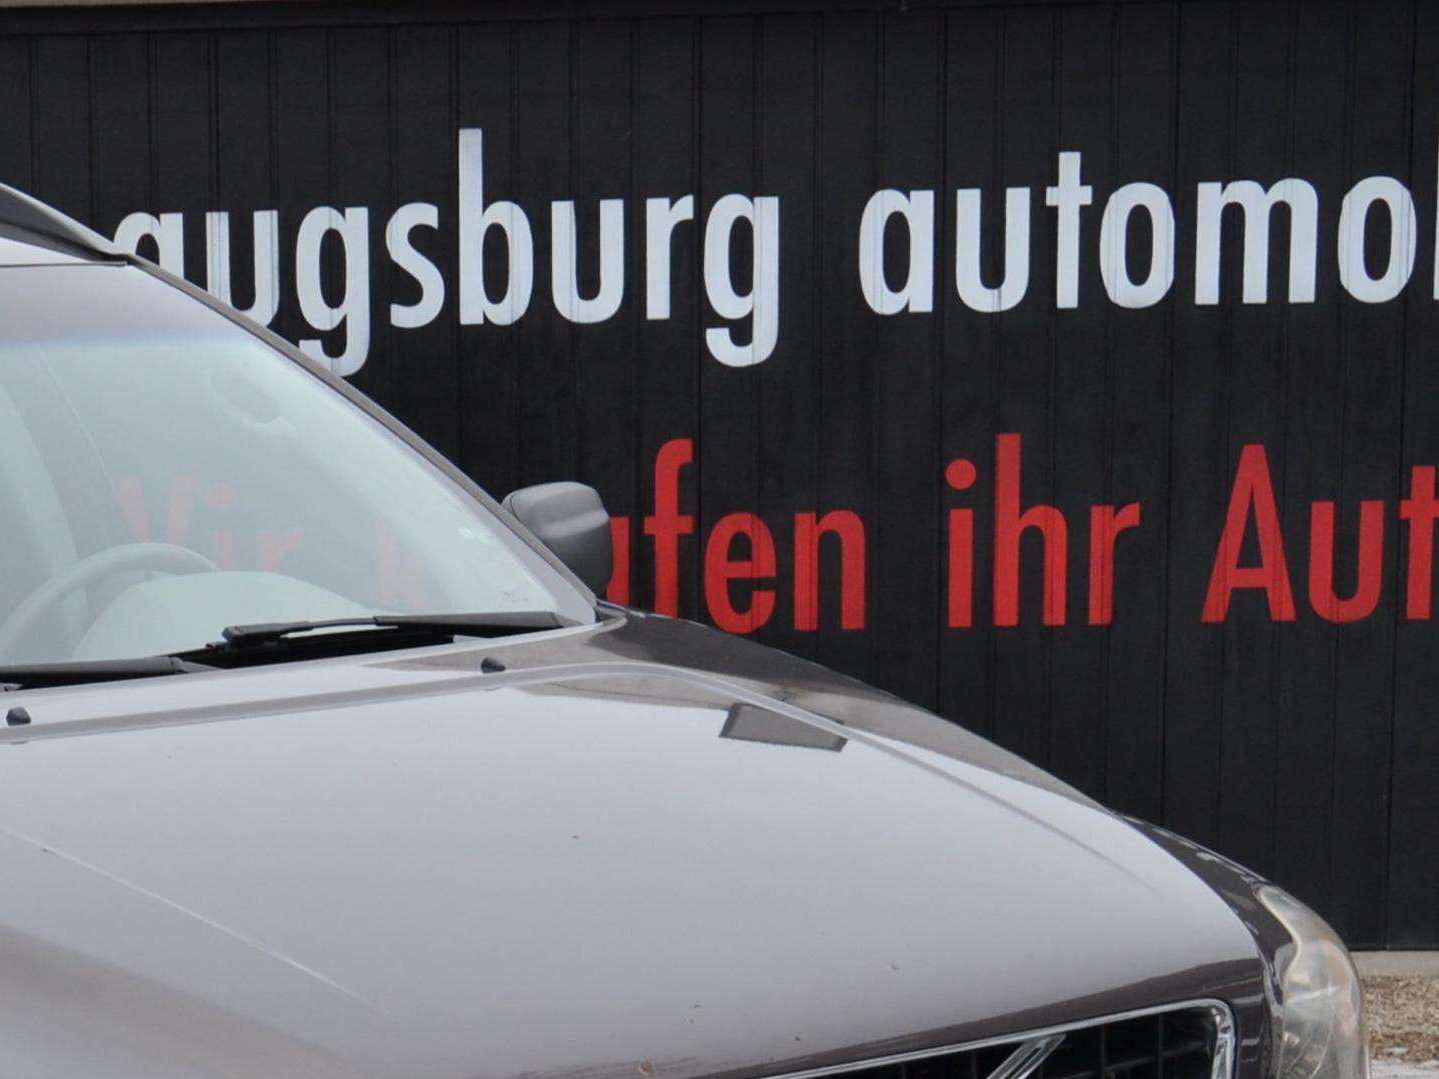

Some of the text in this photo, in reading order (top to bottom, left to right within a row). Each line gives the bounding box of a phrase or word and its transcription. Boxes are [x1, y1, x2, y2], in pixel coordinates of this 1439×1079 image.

[858, 151, 1439, 316] automo
[946, 433, 1140, 628] ihr
[1201, 444, 1439, 623] Aut
